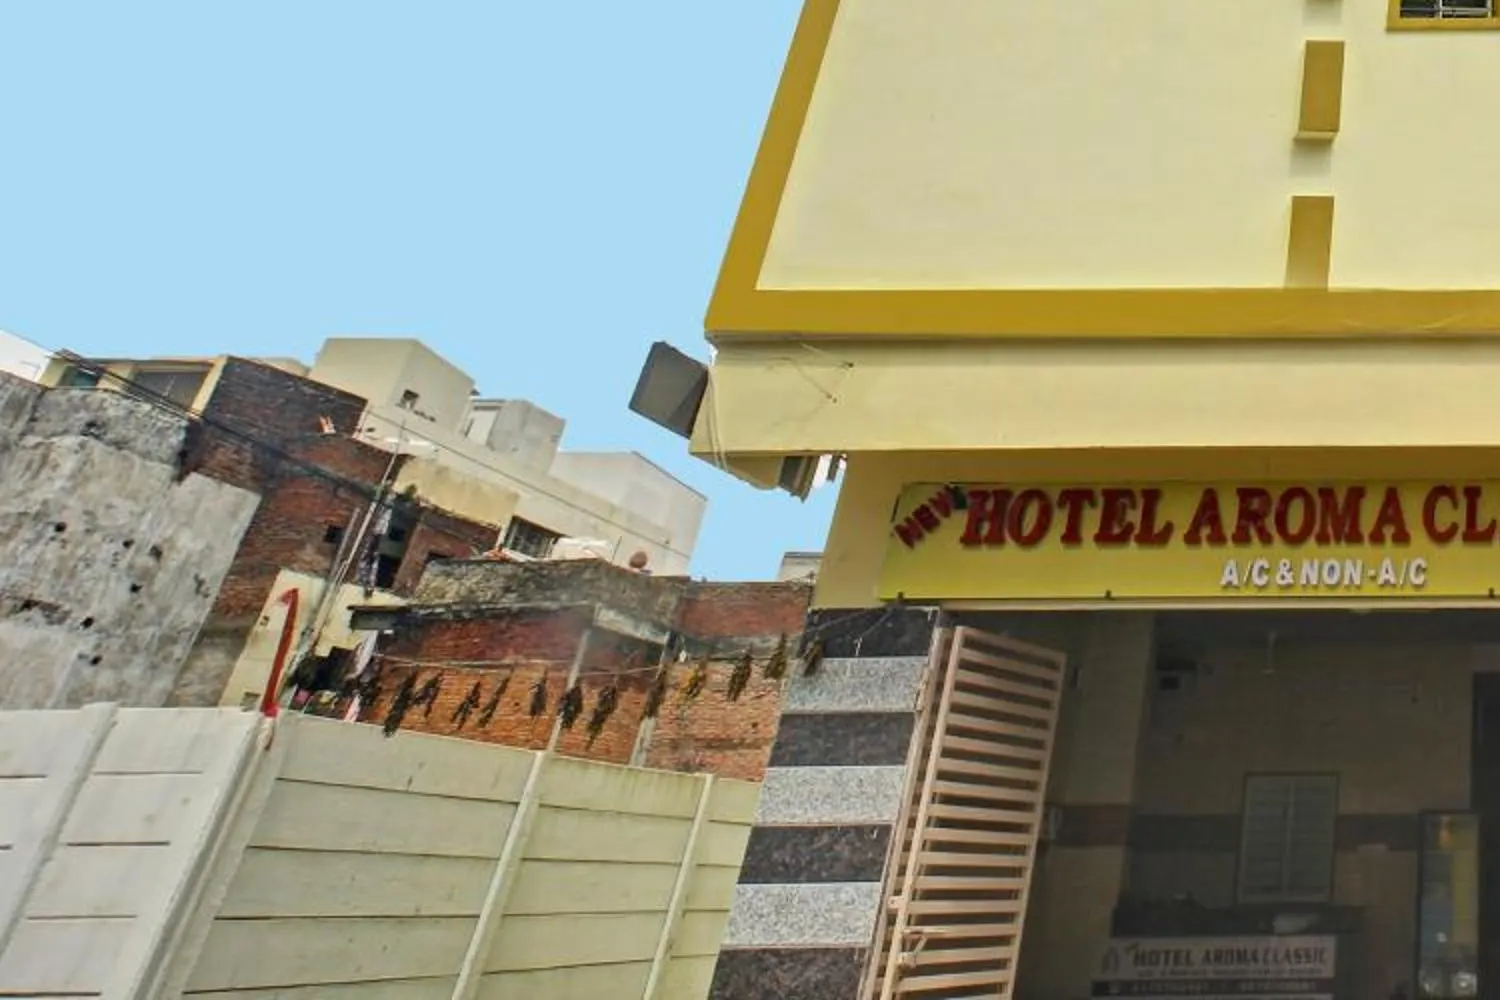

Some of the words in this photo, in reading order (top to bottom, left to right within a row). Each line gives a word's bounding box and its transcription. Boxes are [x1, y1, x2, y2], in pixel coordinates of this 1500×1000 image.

[959, 488, 1175, 546] HOTEL
[1184, 486, 1411, 545] AROMA
[1133, 947, 1194, 967] HOTEL
